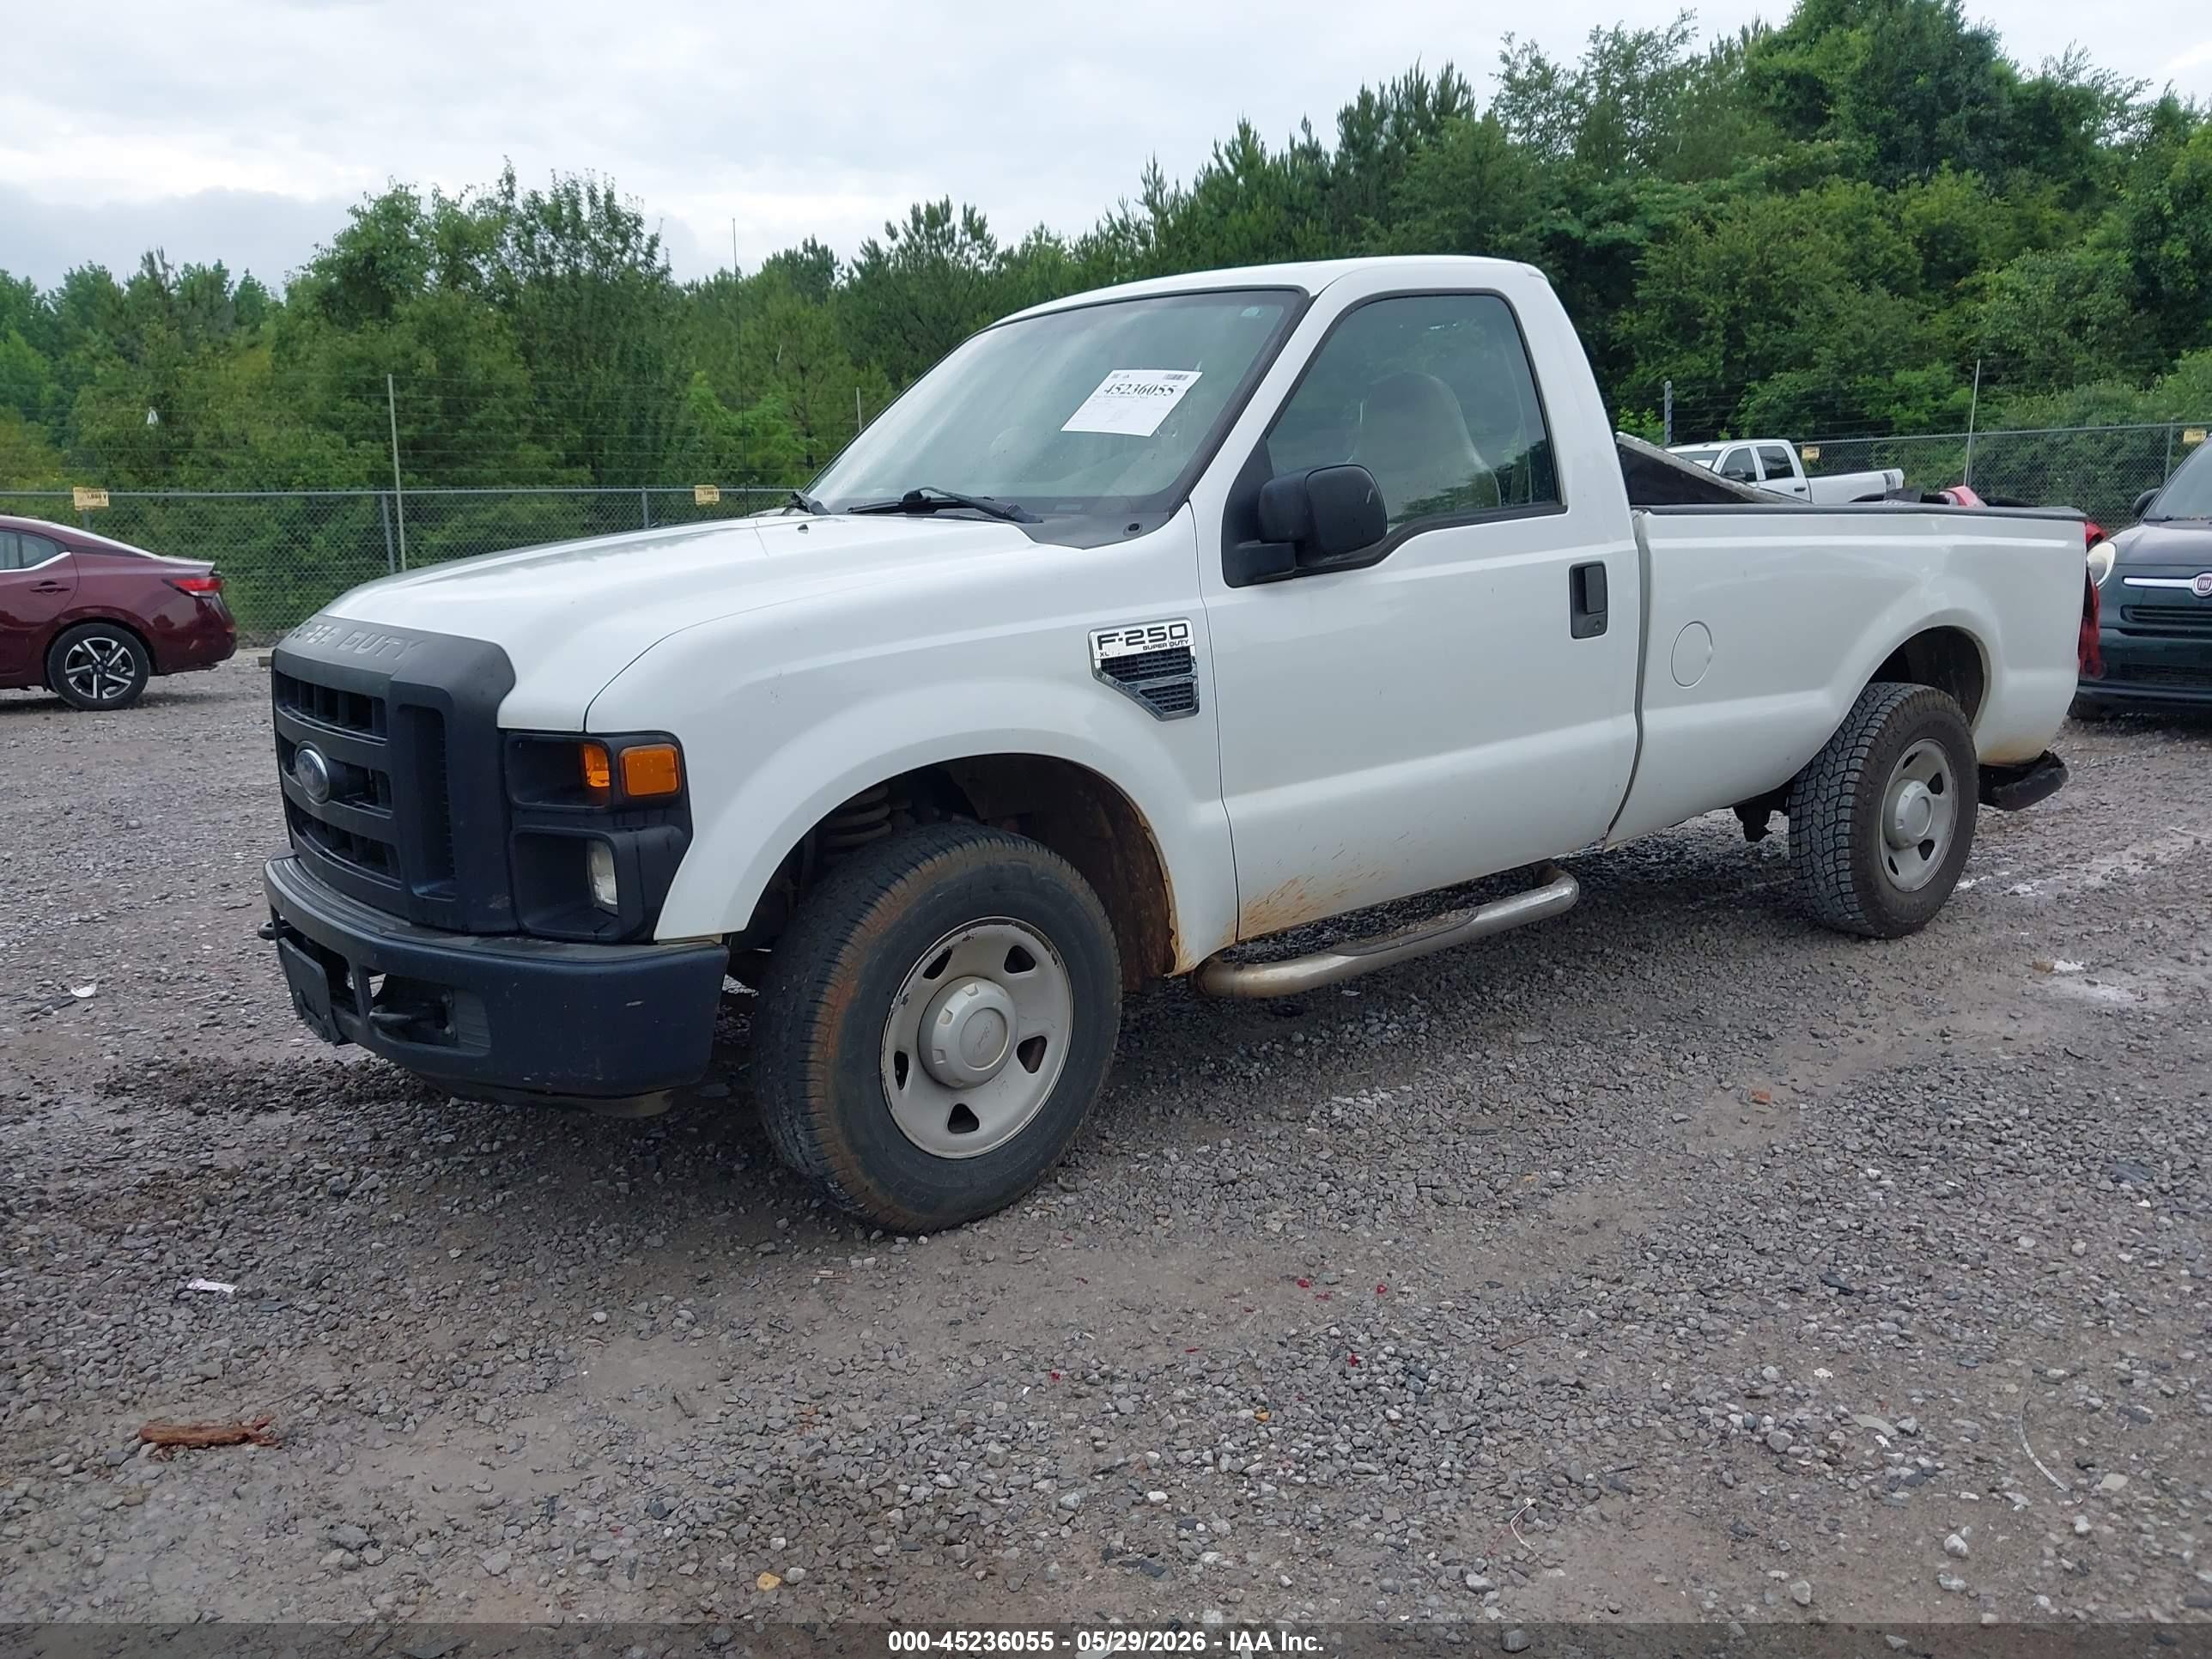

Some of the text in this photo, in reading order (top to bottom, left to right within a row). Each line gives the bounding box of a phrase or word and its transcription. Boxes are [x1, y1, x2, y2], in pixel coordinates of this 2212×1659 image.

[1103, 383, 1177, 397] 45236055
[287, 620, 425, 660] PER DUTY
[1097, 623, 1189, 651] F-250
[1143, 642, 1168, 651] SUPER
